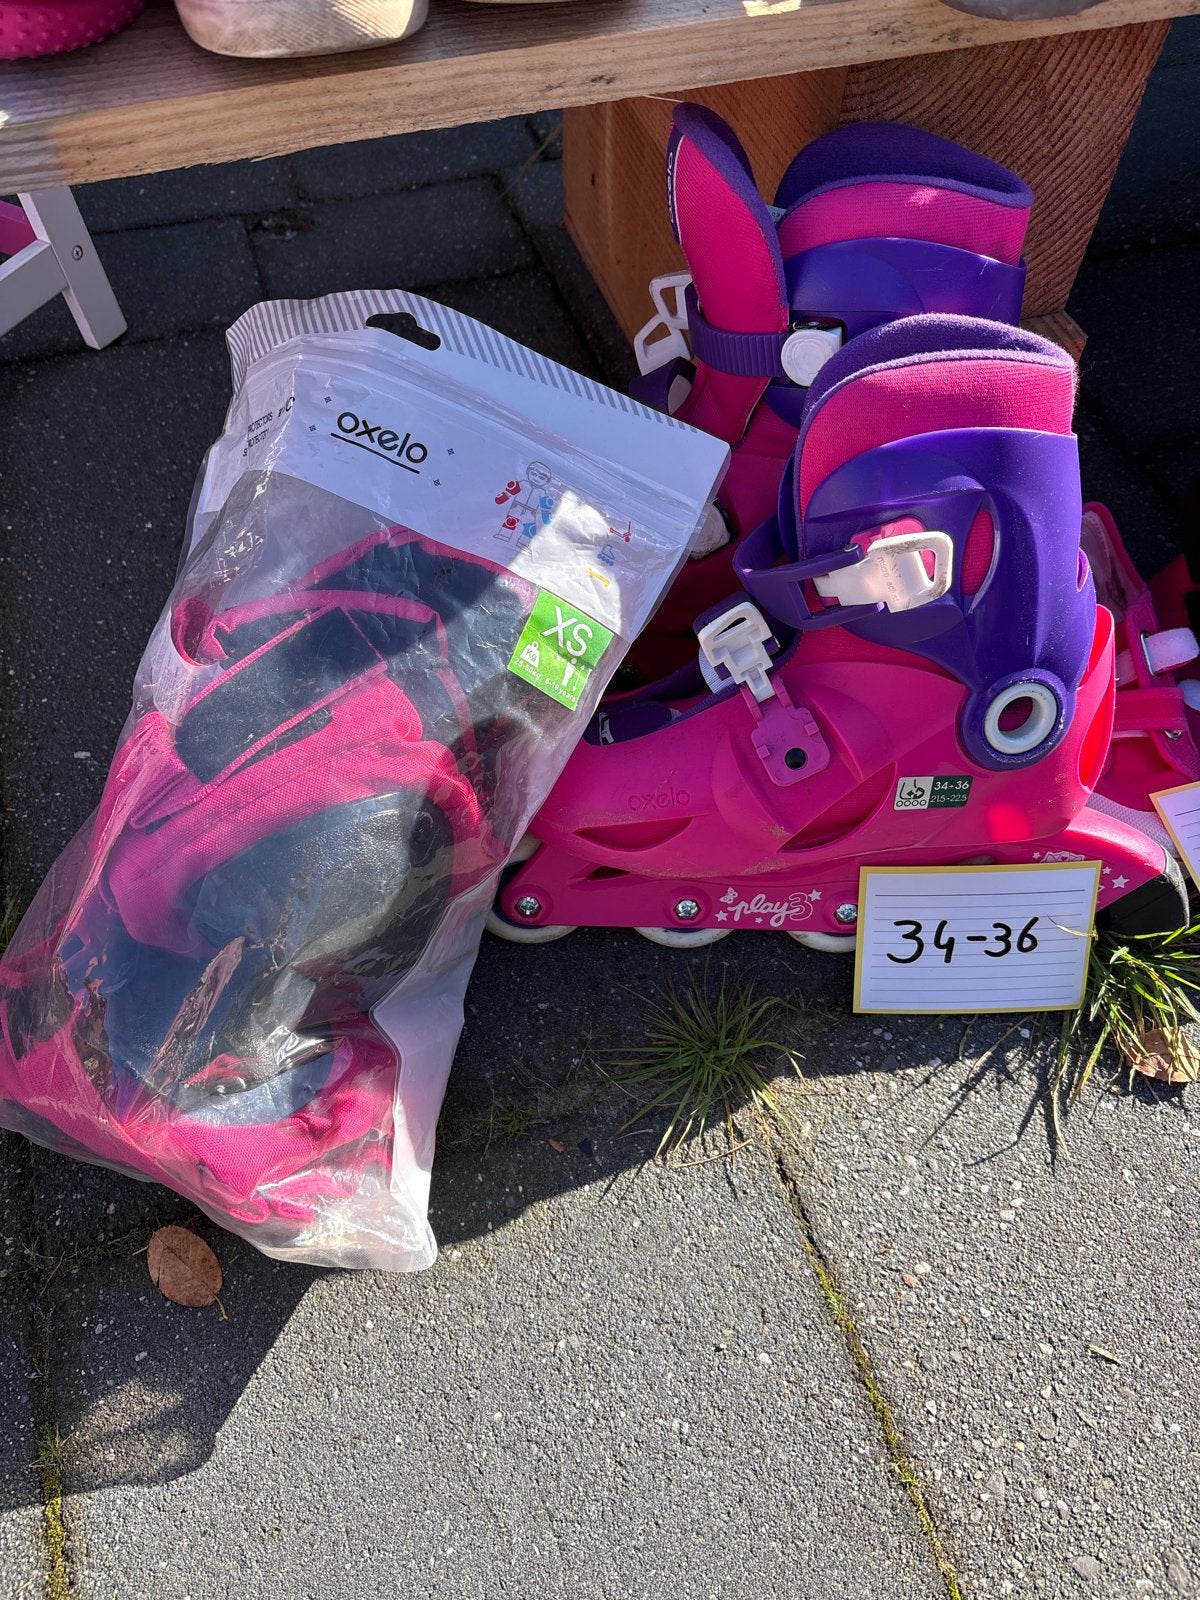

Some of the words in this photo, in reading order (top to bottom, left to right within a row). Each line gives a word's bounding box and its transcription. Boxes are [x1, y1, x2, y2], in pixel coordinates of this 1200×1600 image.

[337, 411, 428, 464] oxelo
[541, 606, 593, 656] XS
[628, 787, 691, 811] oxelo
[934, 780, 970, 791] 34-36
[886, 916, 1039, 964] 34-36
